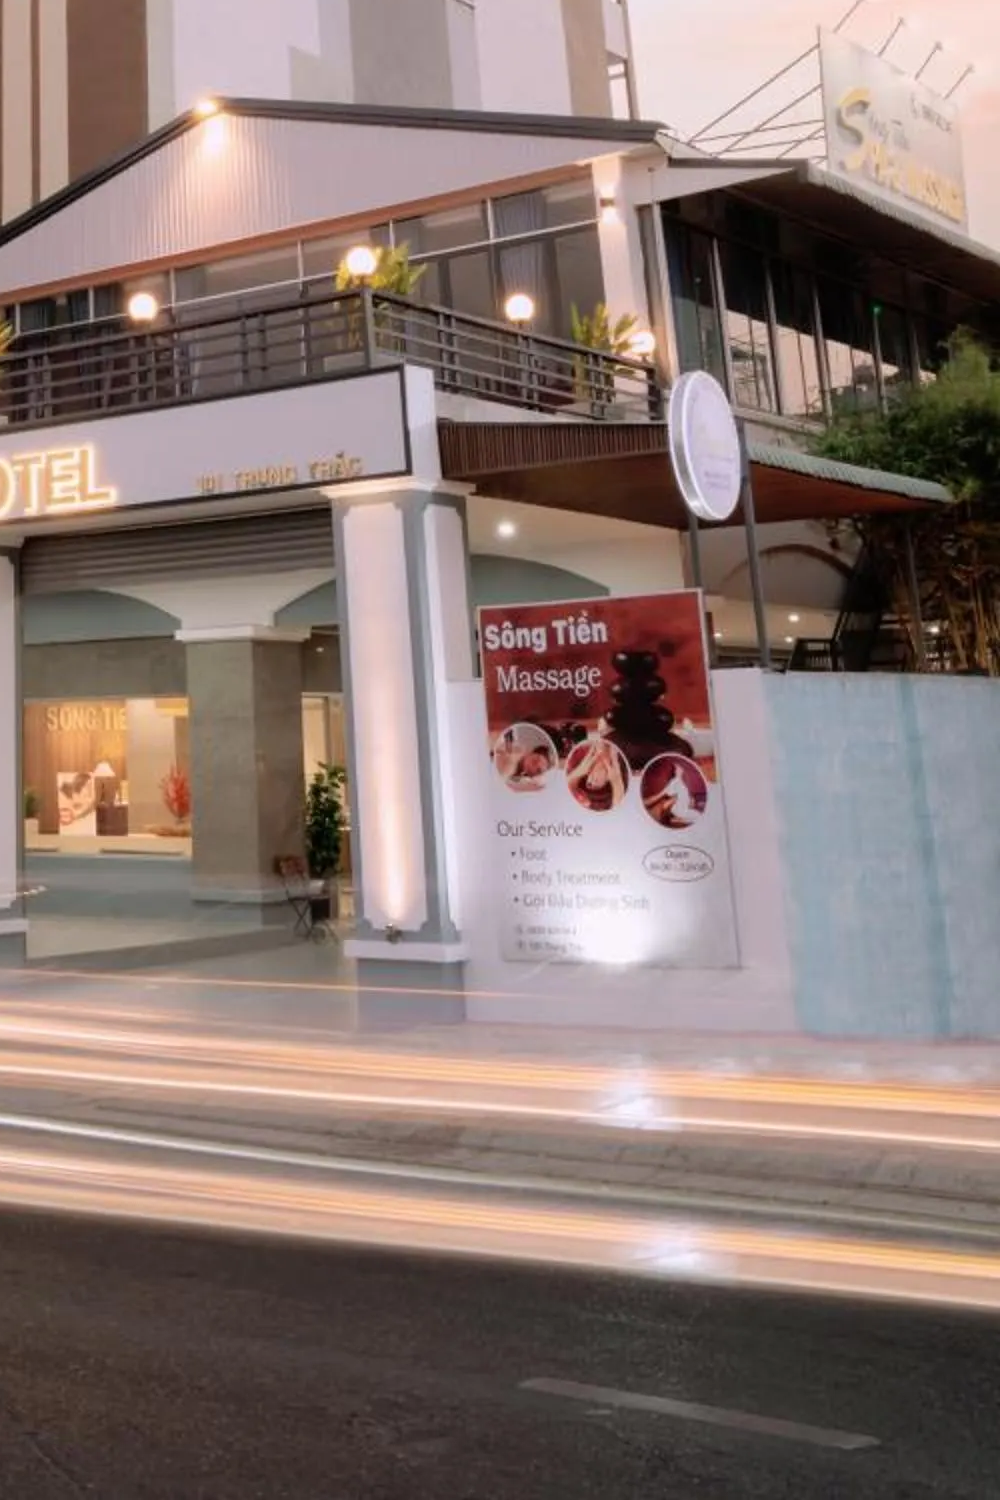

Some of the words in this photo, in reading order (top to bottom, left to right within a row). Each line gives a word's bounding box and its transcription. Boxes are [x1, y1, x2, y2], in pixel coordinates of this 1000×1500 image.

[485, 621, 547, 653] Sông
[552, 610, 608, 645] Tiền
[496, 665, 601, 697] Massage
[497, 820, 524, 837] Our
[528, 820, 583, 837] Service
